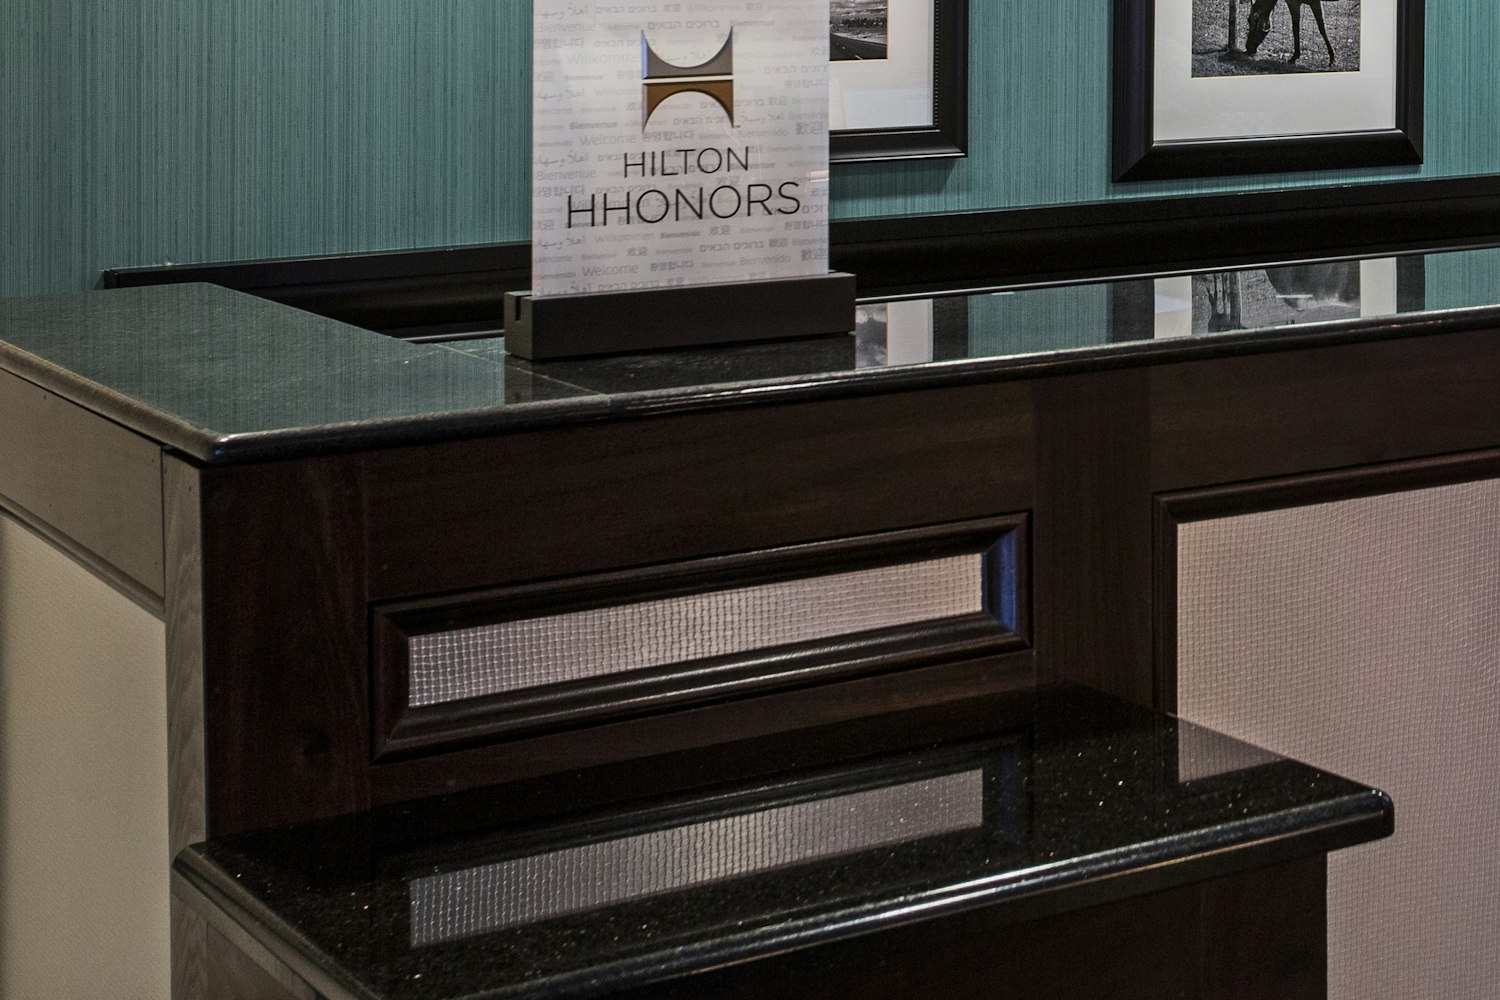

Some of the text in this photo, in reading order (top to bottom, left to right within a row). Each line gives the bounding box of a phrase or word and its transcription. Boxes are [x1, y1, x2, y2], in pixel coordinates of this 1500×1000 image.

[578, 133, 637, 146] Welcome
[623, 145, 750, 179] HILTON
[567, 181, 801, 229] HHONORS
[582, 263, 640, 277] Welcome
